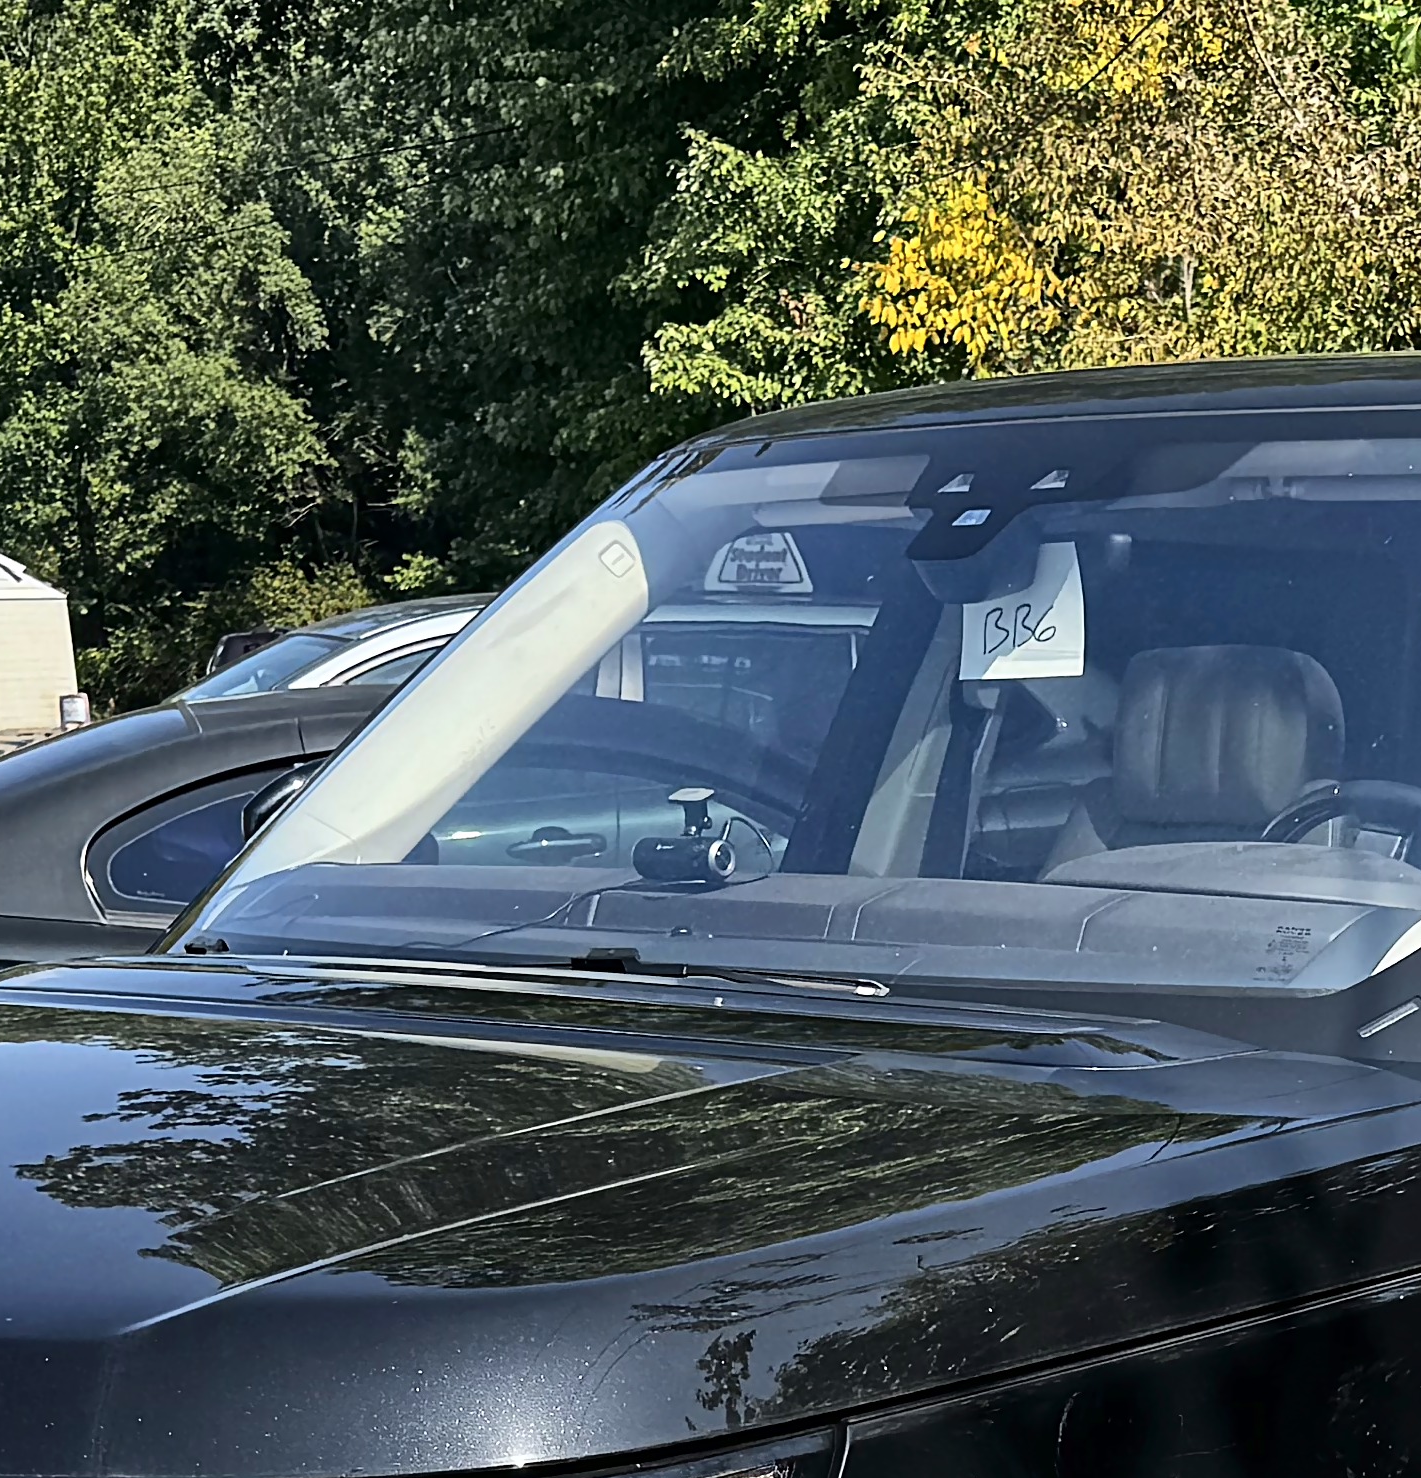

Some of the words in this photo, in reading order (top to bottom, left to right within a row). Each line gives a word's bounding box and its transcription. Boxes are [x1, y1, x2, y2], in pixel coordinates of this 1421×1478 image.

[730, 545, 787, 563] Student
[737, 563, 783, 581] Driver
[983, 603, 1057, 655] BB6
